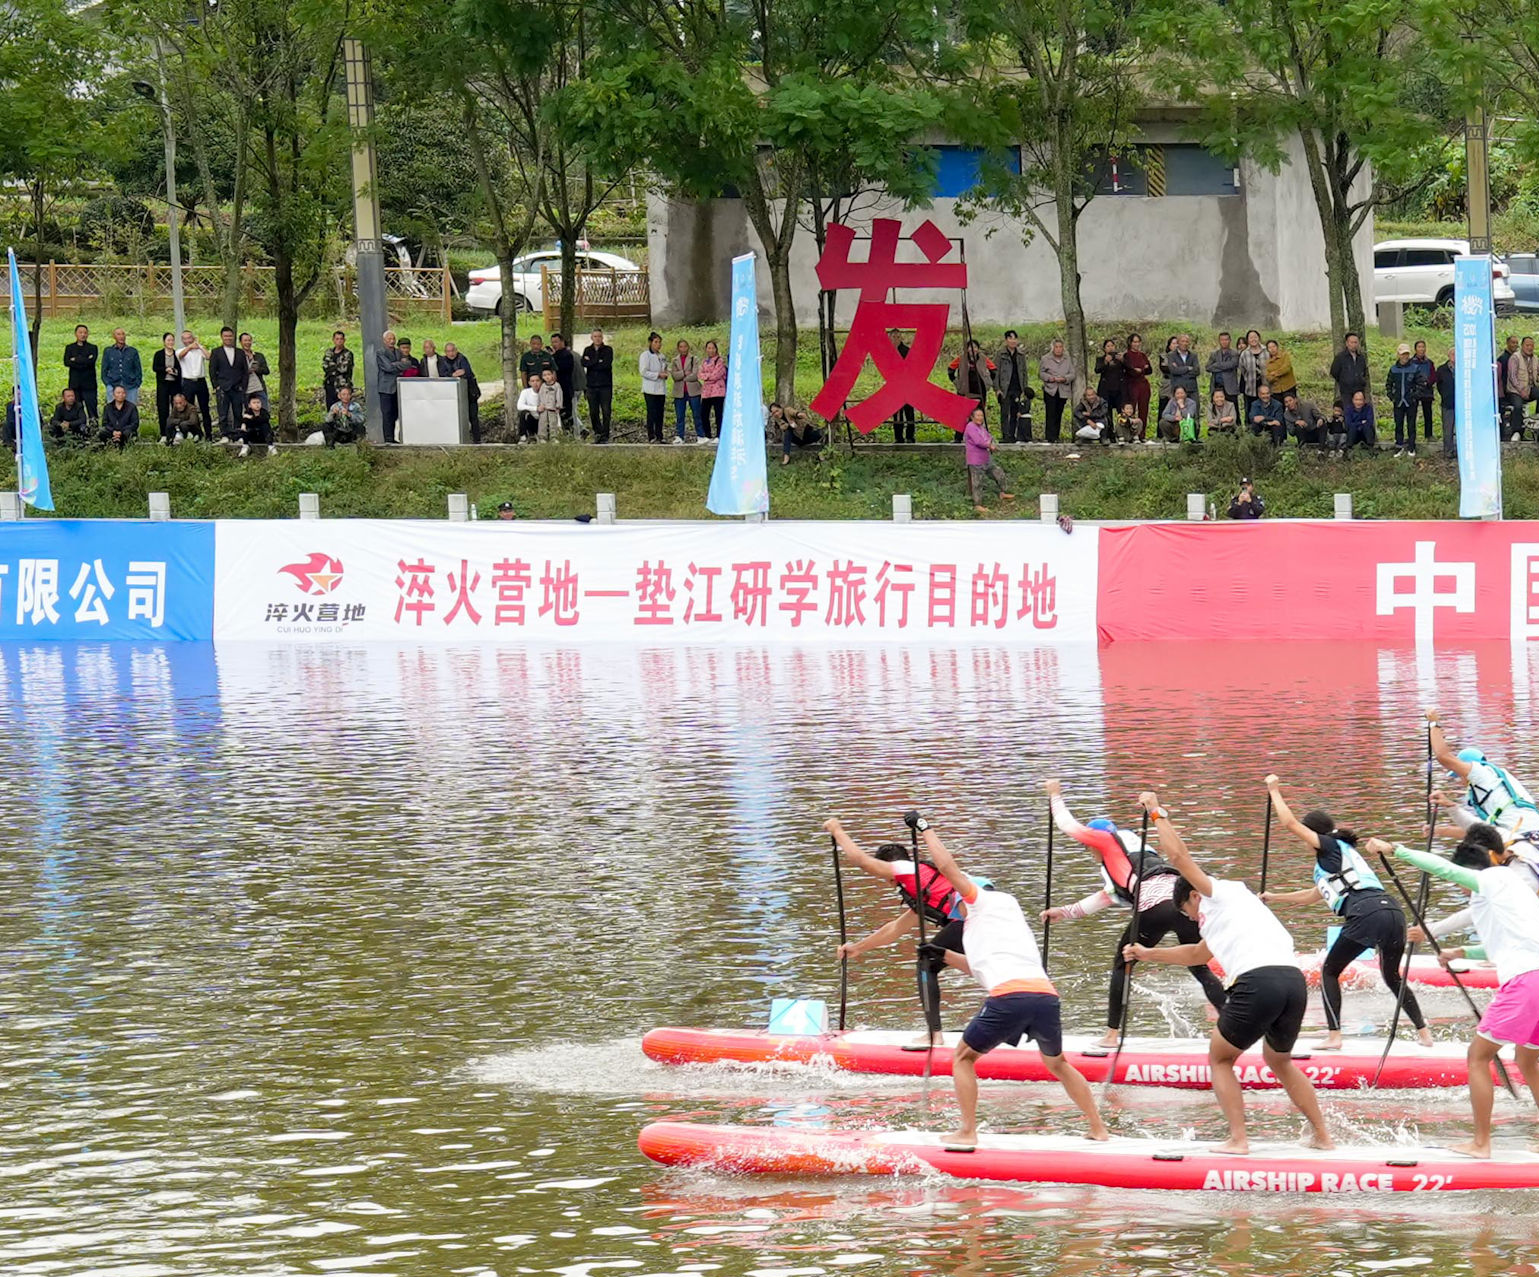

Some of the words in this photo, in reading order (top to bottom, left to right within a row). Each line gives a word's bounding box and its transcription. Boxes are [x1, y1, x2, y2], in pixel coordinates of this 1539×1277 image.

[811, 220, 969, 434] 发
[0, 559, 166, 627] 限公司
[265, 603, 366, 622] 淬火营地
[783, 1000, 809, 1034] 4
[1124, 1064, 1212, 1083] AIRSHI
[1233, 1066, 1283, 1084] RAC
[1202, 1170, 1315, 1192] AIRSHIP
[1321, 1173, 1394, 1192] RACE
[1411, 1174, 1454, 1192] 22'
